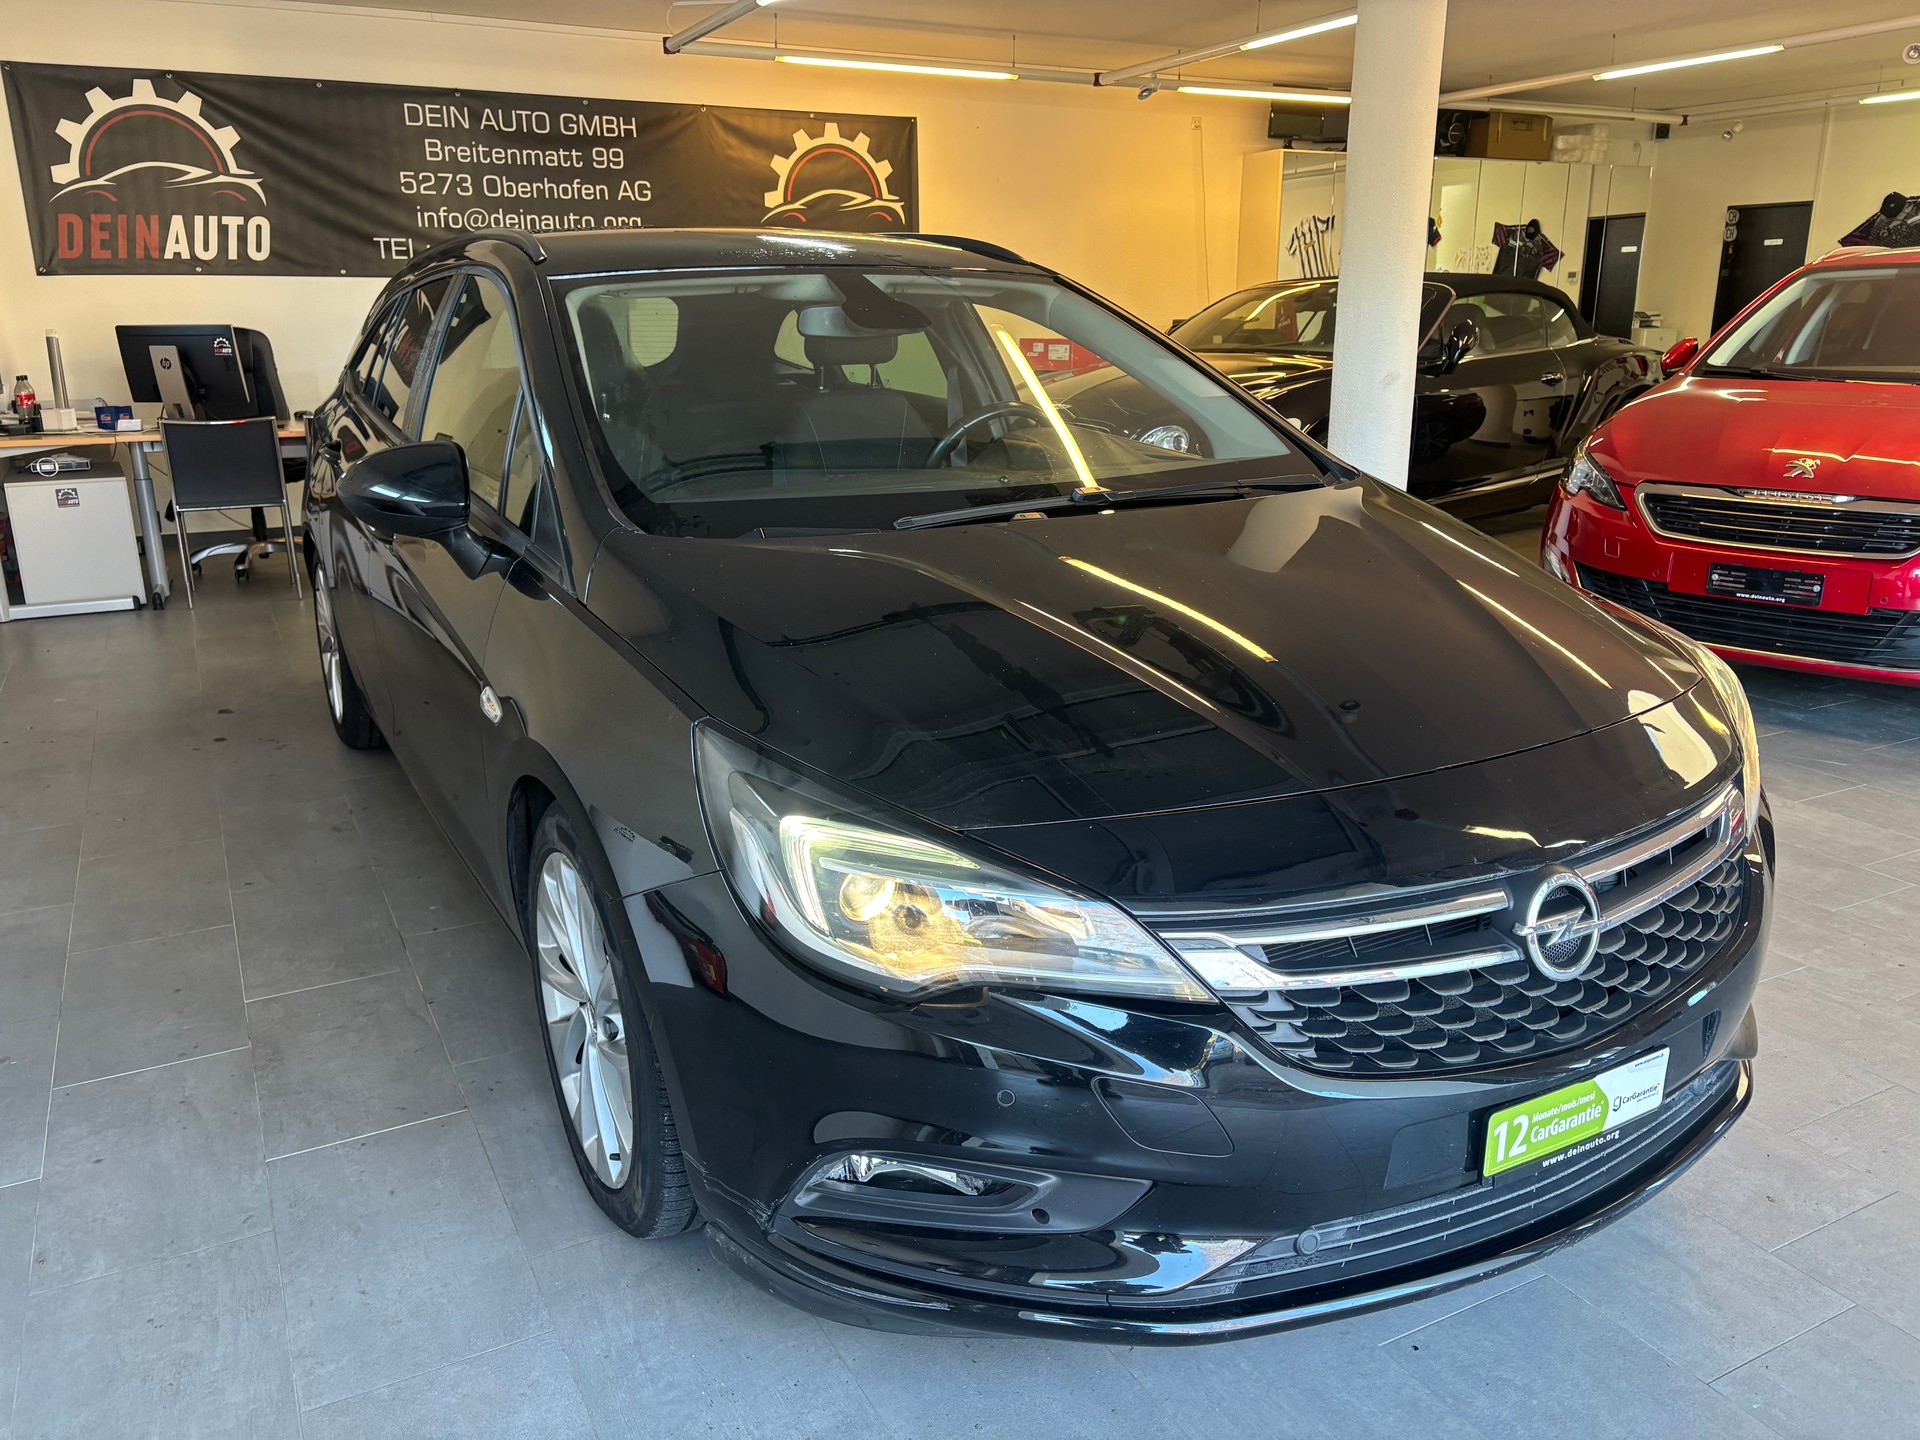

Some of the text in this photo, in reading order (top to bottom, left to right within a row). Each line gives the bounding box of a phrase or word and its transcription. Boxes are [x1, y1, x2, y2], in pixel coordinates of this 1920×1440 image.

[403, 103, 637, 138] DEIN AUTO GMBH
[424, 138, 624, 170] Breitenmatt 99
[399, 171, 652, 202] 5273 Oberhofen AG
[57, 213, 271, 260] DEINAUTO
[1493, 1114, 1530, 1163] 12
[1530, 1103, 1602, 1143] CarGarantie
[1542, 1130, 1620, 1168] www.deinauto.org
